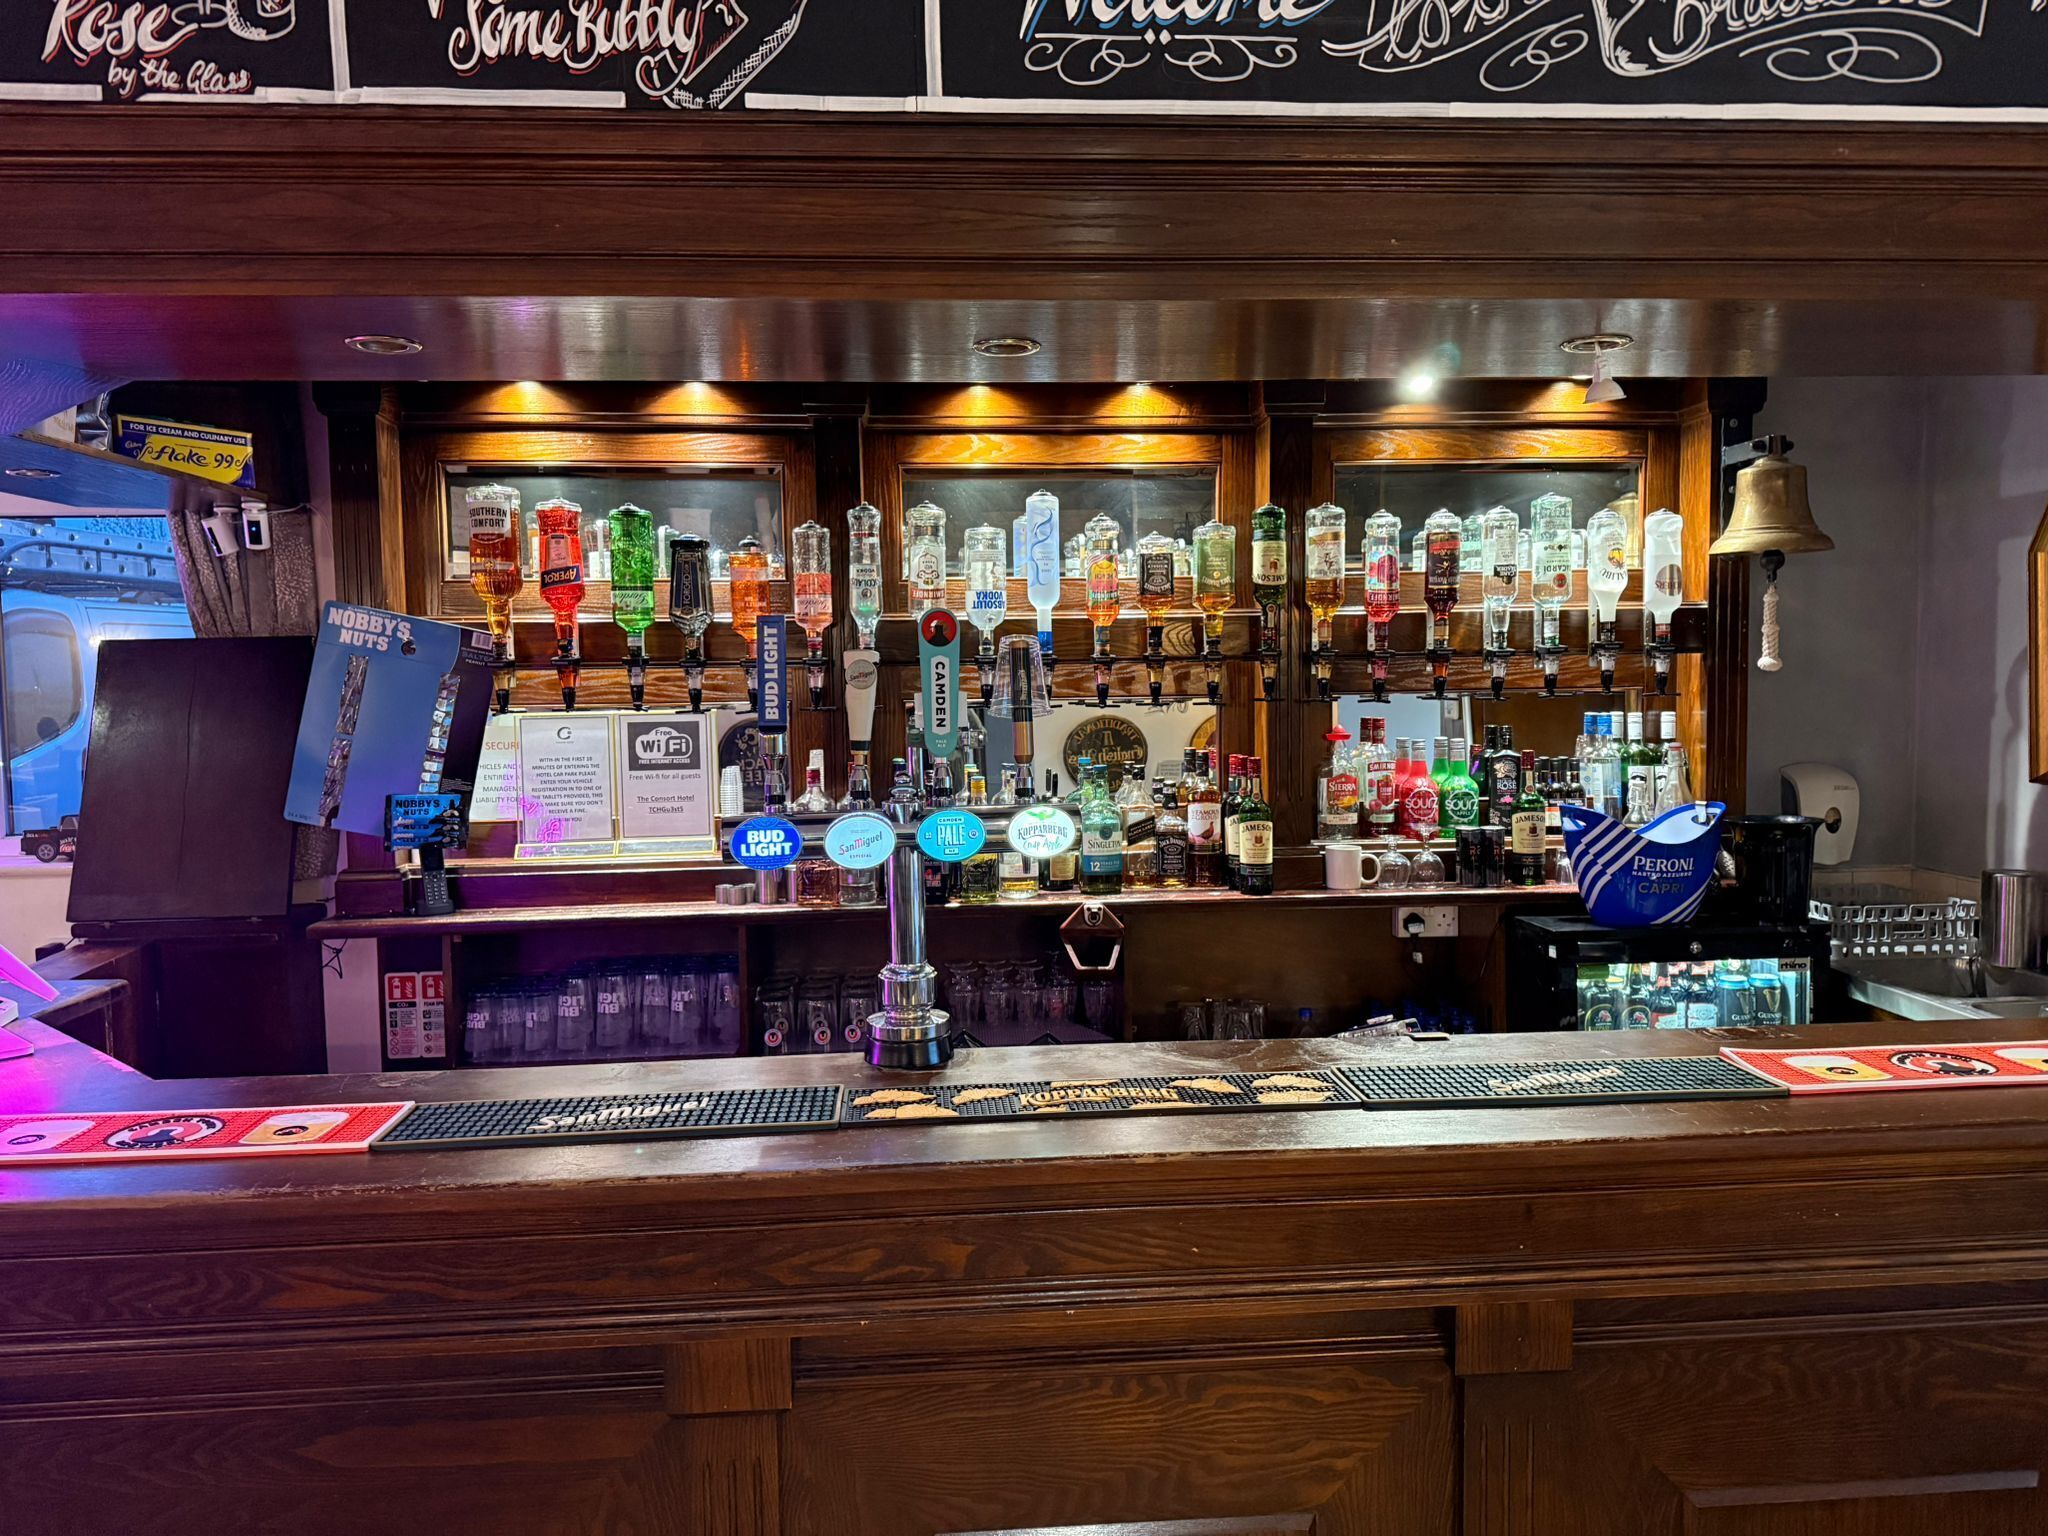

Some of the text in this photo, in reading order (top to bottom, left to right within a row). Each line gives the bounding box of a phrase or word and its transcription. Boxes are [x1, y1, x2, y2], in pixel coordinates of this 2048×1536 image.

[449, 0, 571, 71] Some
[108, 58, 250, 94] by the Glass
[129, 423, 246, 445] FOR ICE CREAM AND CULINARY USE
[213, 453, 235, 470] 99
[469, 506, 508, 519] SOUTHERN
[470, 517, 506, 529] COMFORT
[543, 566, 578, 585] APEROL
[972, 600, 1006, 609] ABSOLUT
[976, 591, 1005, 601] VODKA
[327, 607, 412, 640] NOBBY'S
[339, 628, 390, 651] NUTS
[764, 625, 779, 720] BUD LIGHT
[935, 661, 947, 729] CAMDEN
[1328, 782, 1357, 792] SIERRA
[403, 808, 430, 816] NUTS
[746, 829, 786, 843] BUD
[937, 823, 967, 848] PALE
[1017, 824, 1069, 841] KOPPARBERG
[740, 842, 793, 857] LIGHT
[1089, 861, 1101, 872] 12
[1633, 855, 1694, 872] PERONI
[1638, 882, 1685, 894] CAPRI
[1018, 1085, 1180, 1108] KOPPARBERG
